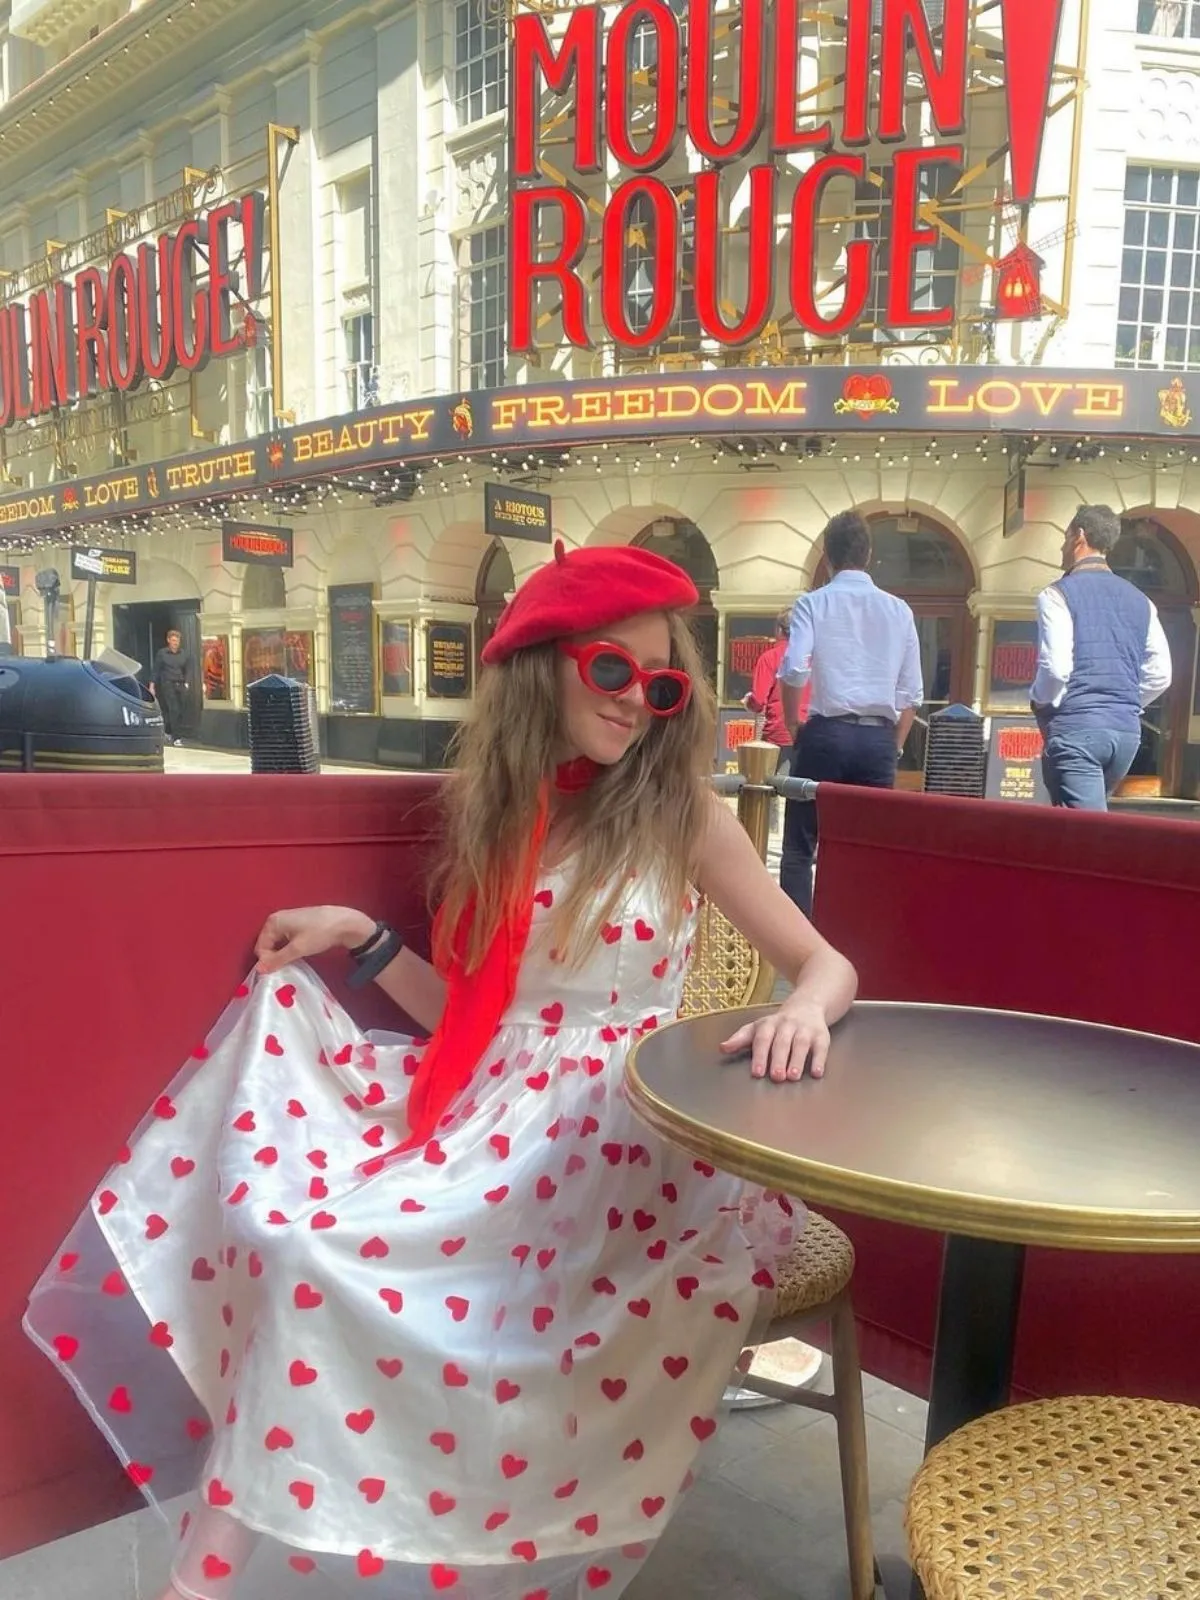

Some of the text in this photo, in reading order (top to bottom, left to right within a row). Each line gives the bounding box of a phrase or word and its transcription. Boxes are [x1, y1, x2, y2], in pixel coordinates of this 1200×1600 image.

[511, 0, 966, 178] MOULIN
[491, 382, 807, 430] FREEDOM
[926, 379, 1124, 416] LOVE
[292, 409, 435, 462] BEAUTY
[84, 477, 139, 507] LOVE
[166, 450, 256, 490] TRUTH
